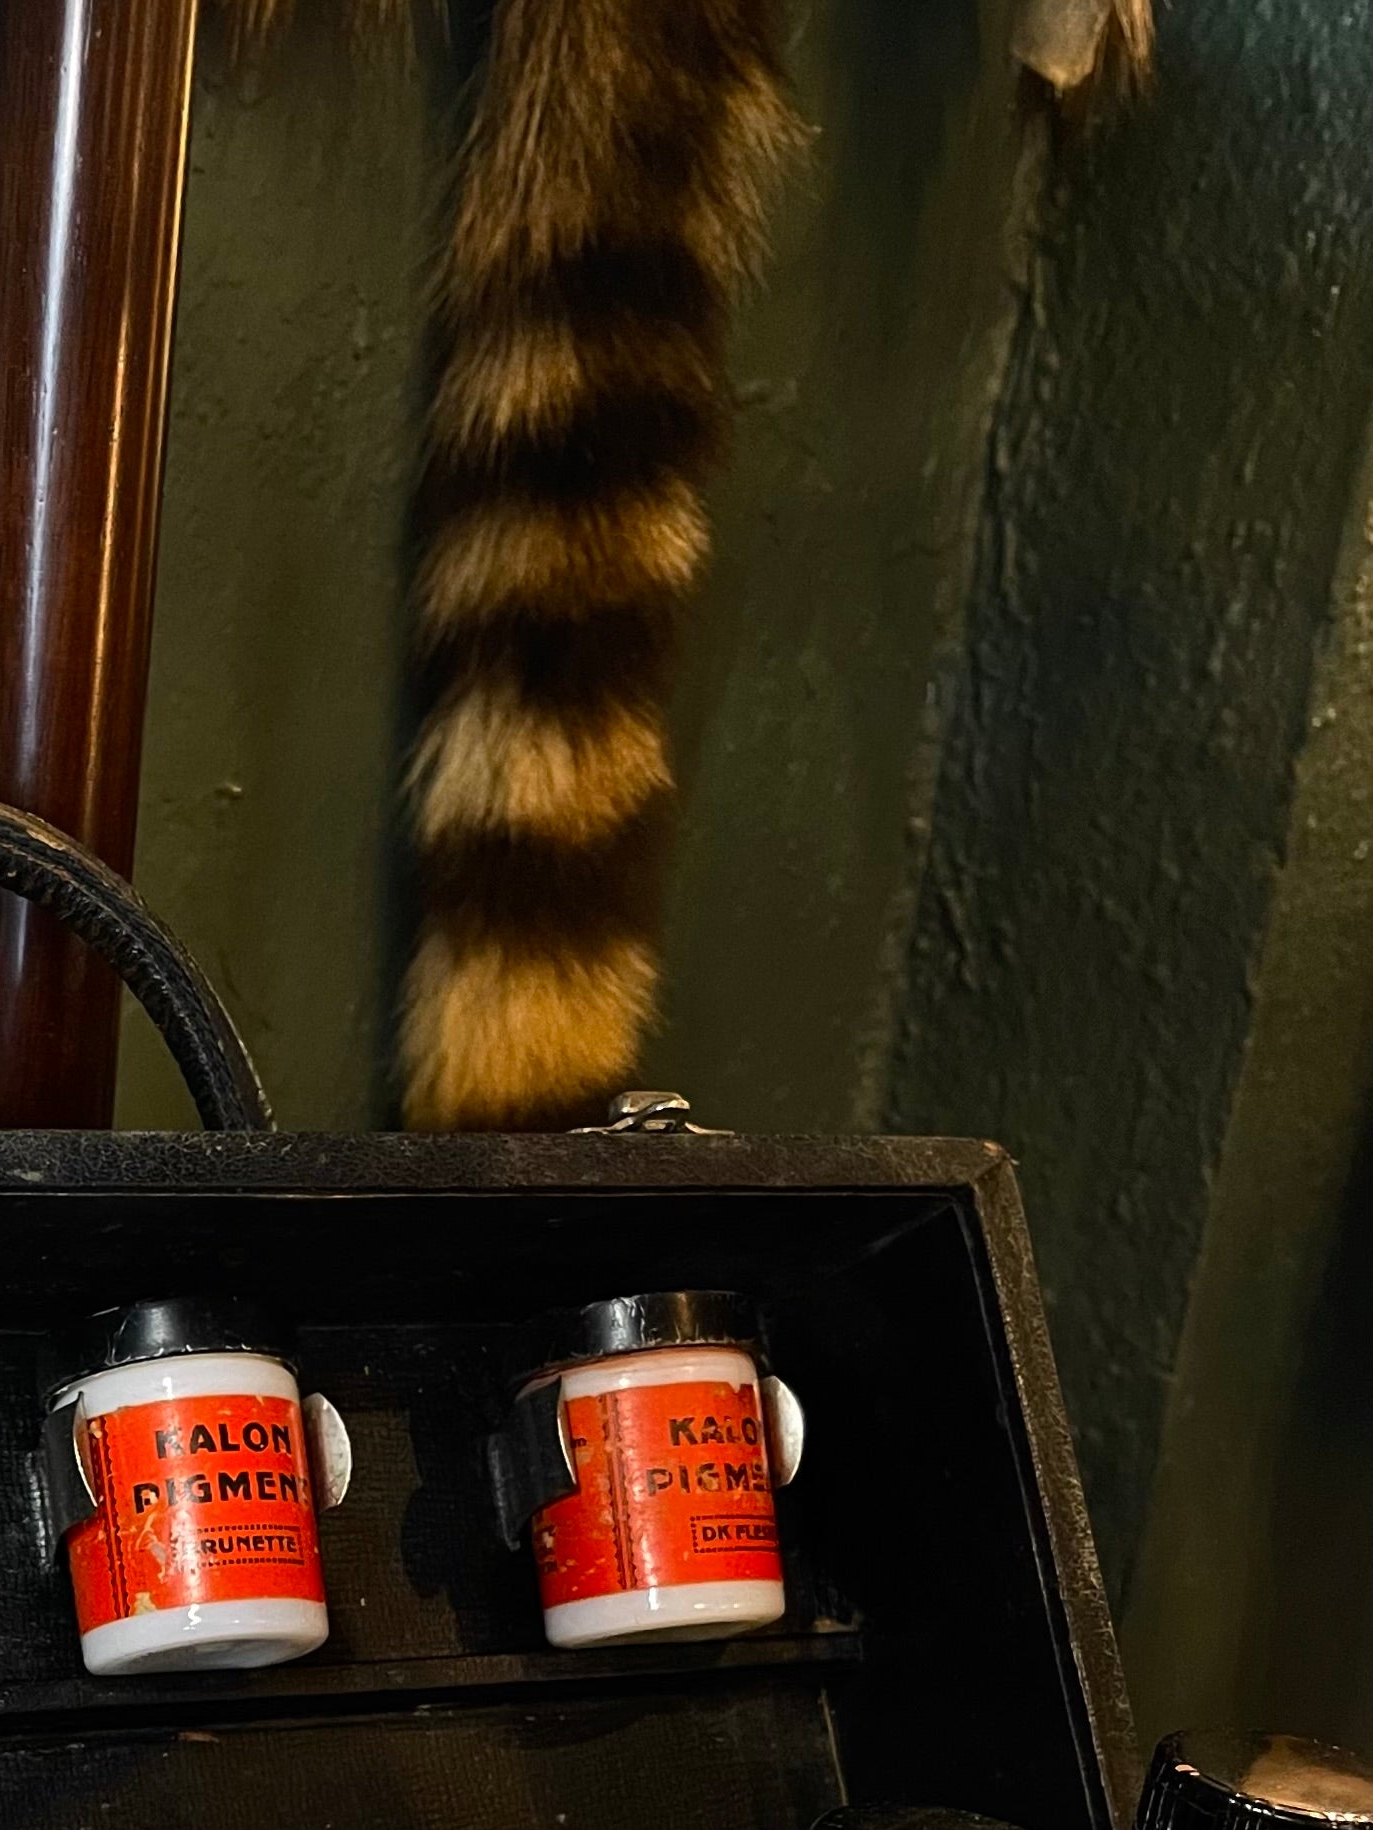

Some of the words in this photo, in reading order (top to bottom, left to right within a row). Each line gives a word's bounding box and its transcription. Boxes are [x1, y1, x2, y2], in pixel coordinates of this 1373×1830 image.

[156, 1421, 292, 1459] KALON
[670, 1416, 760, 1447] KALO
[183, 1535, 299, 1556] RUNETTE
[701, 1525, 731, 1543] DK
